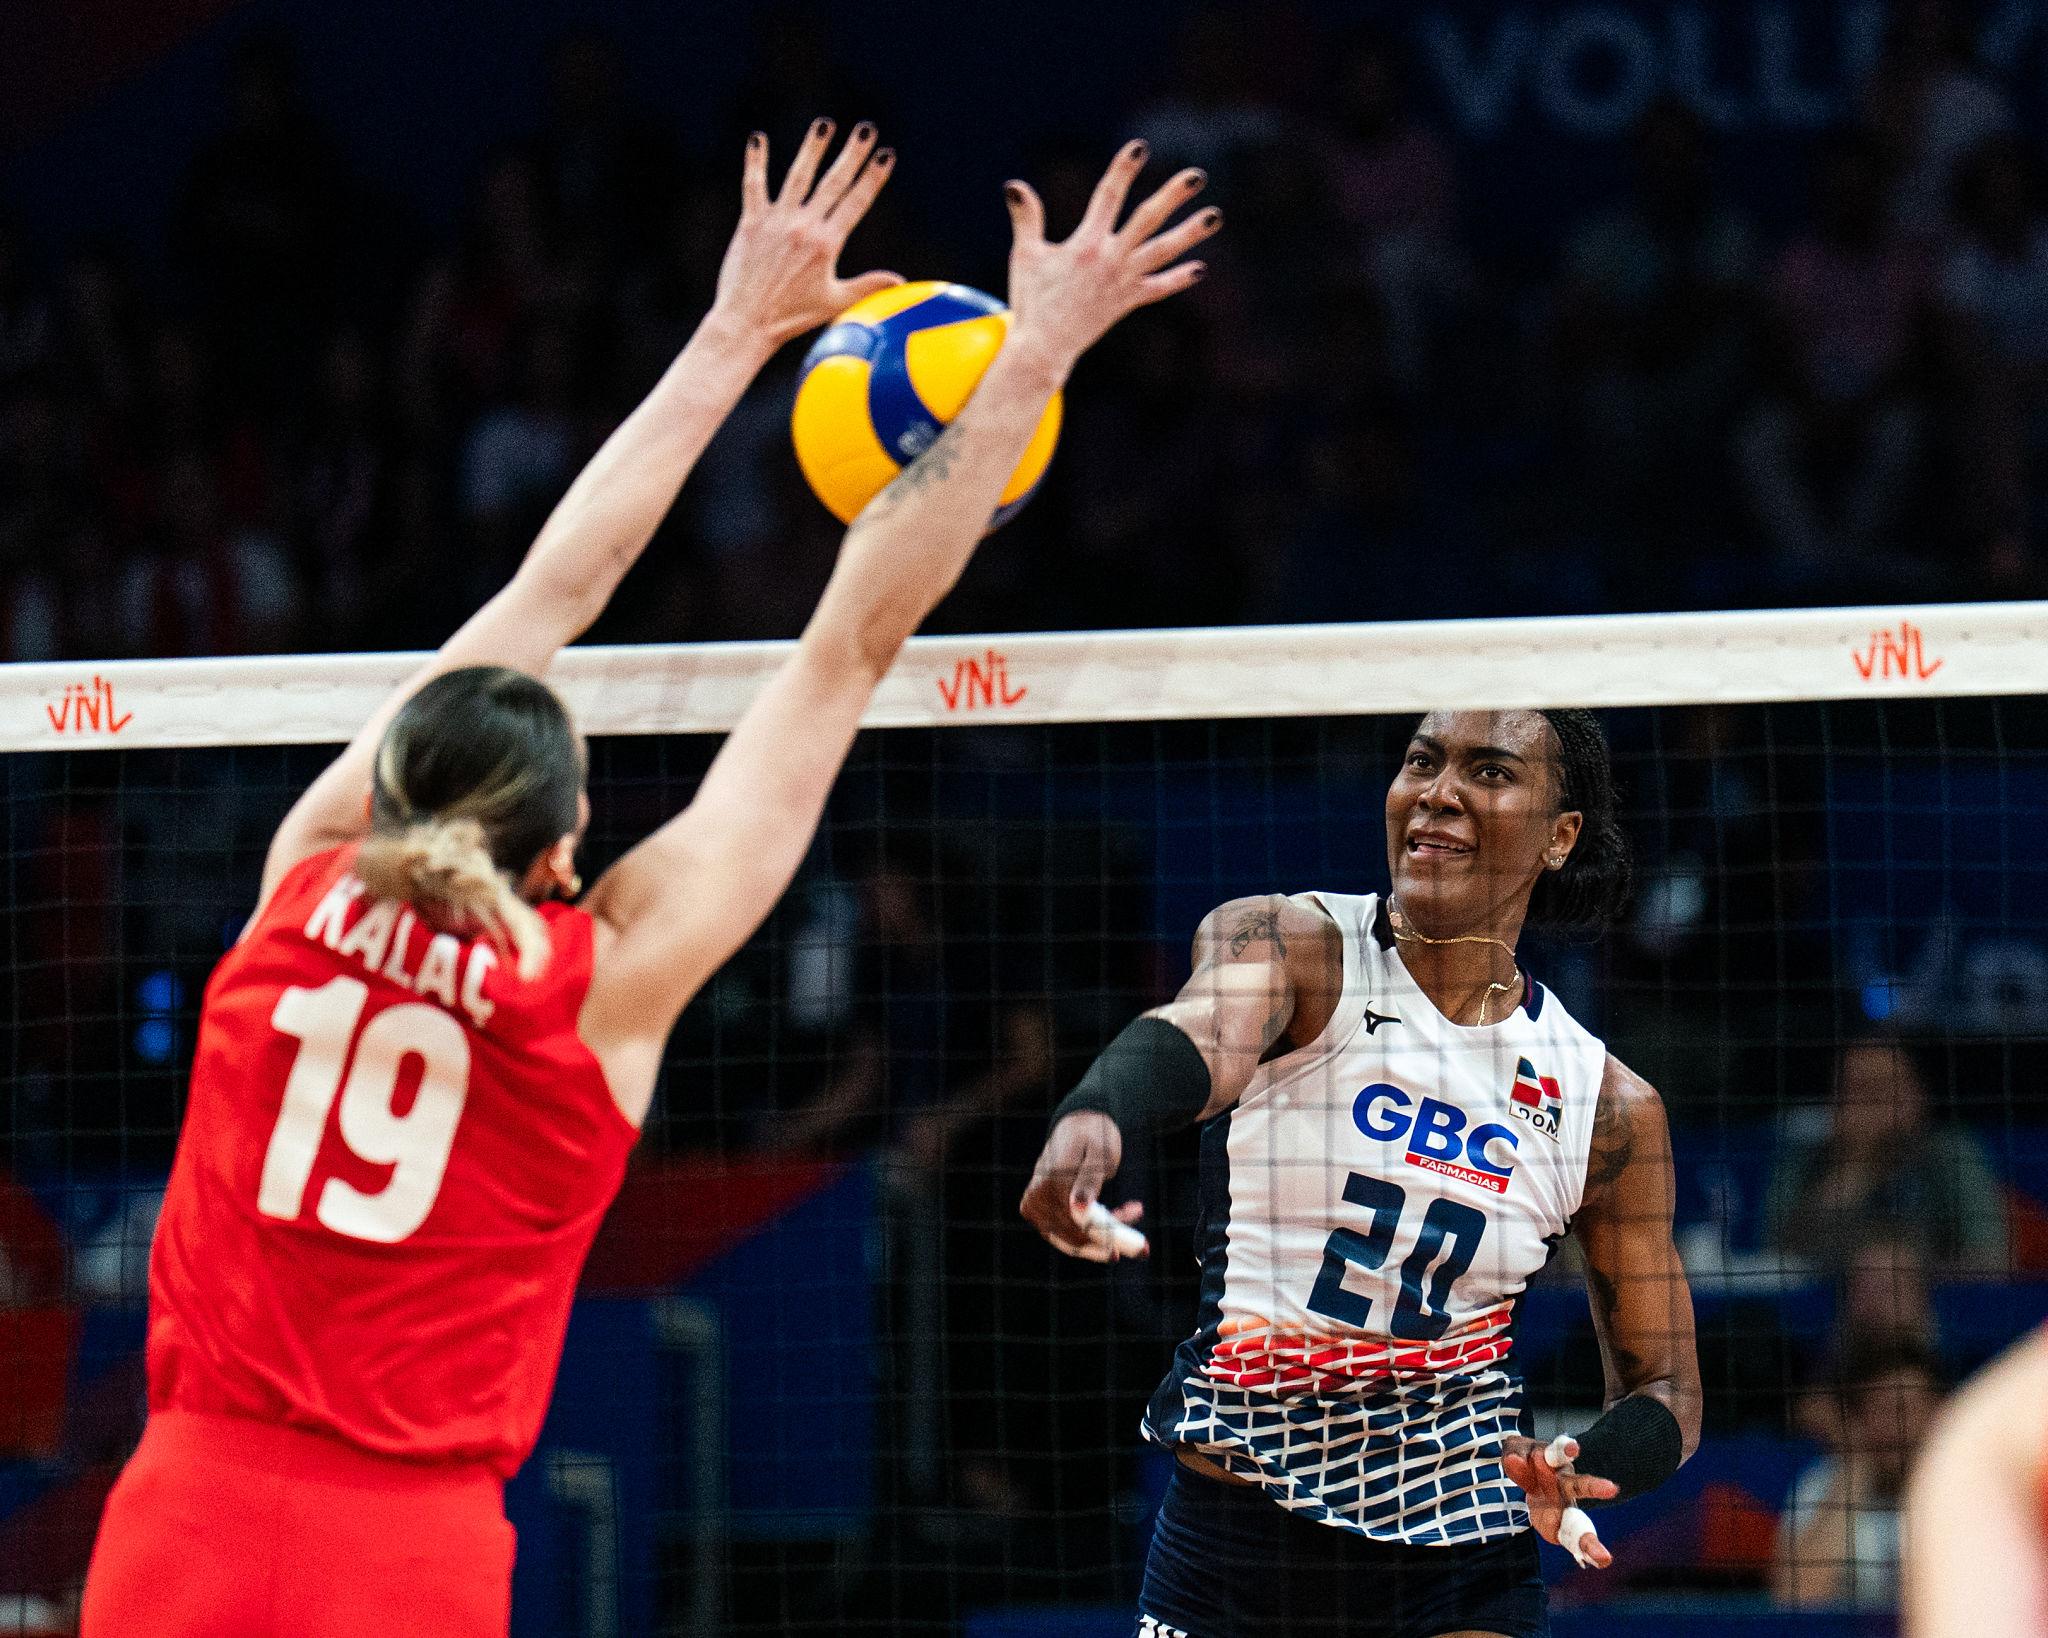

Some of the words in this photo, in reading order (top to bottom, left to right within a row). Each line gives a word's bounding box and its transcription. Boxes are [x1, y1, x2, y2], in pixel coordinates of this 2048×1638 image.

[257, 974, 471, 1243] 19
[1352, 1083, 1519, 1177] GBC
[1518, 1107, 1558, 1138] DOM
[1418, 1157, 1500, 1192] FARMACIAS
[1306, 1171, 1487, 1341] 20
